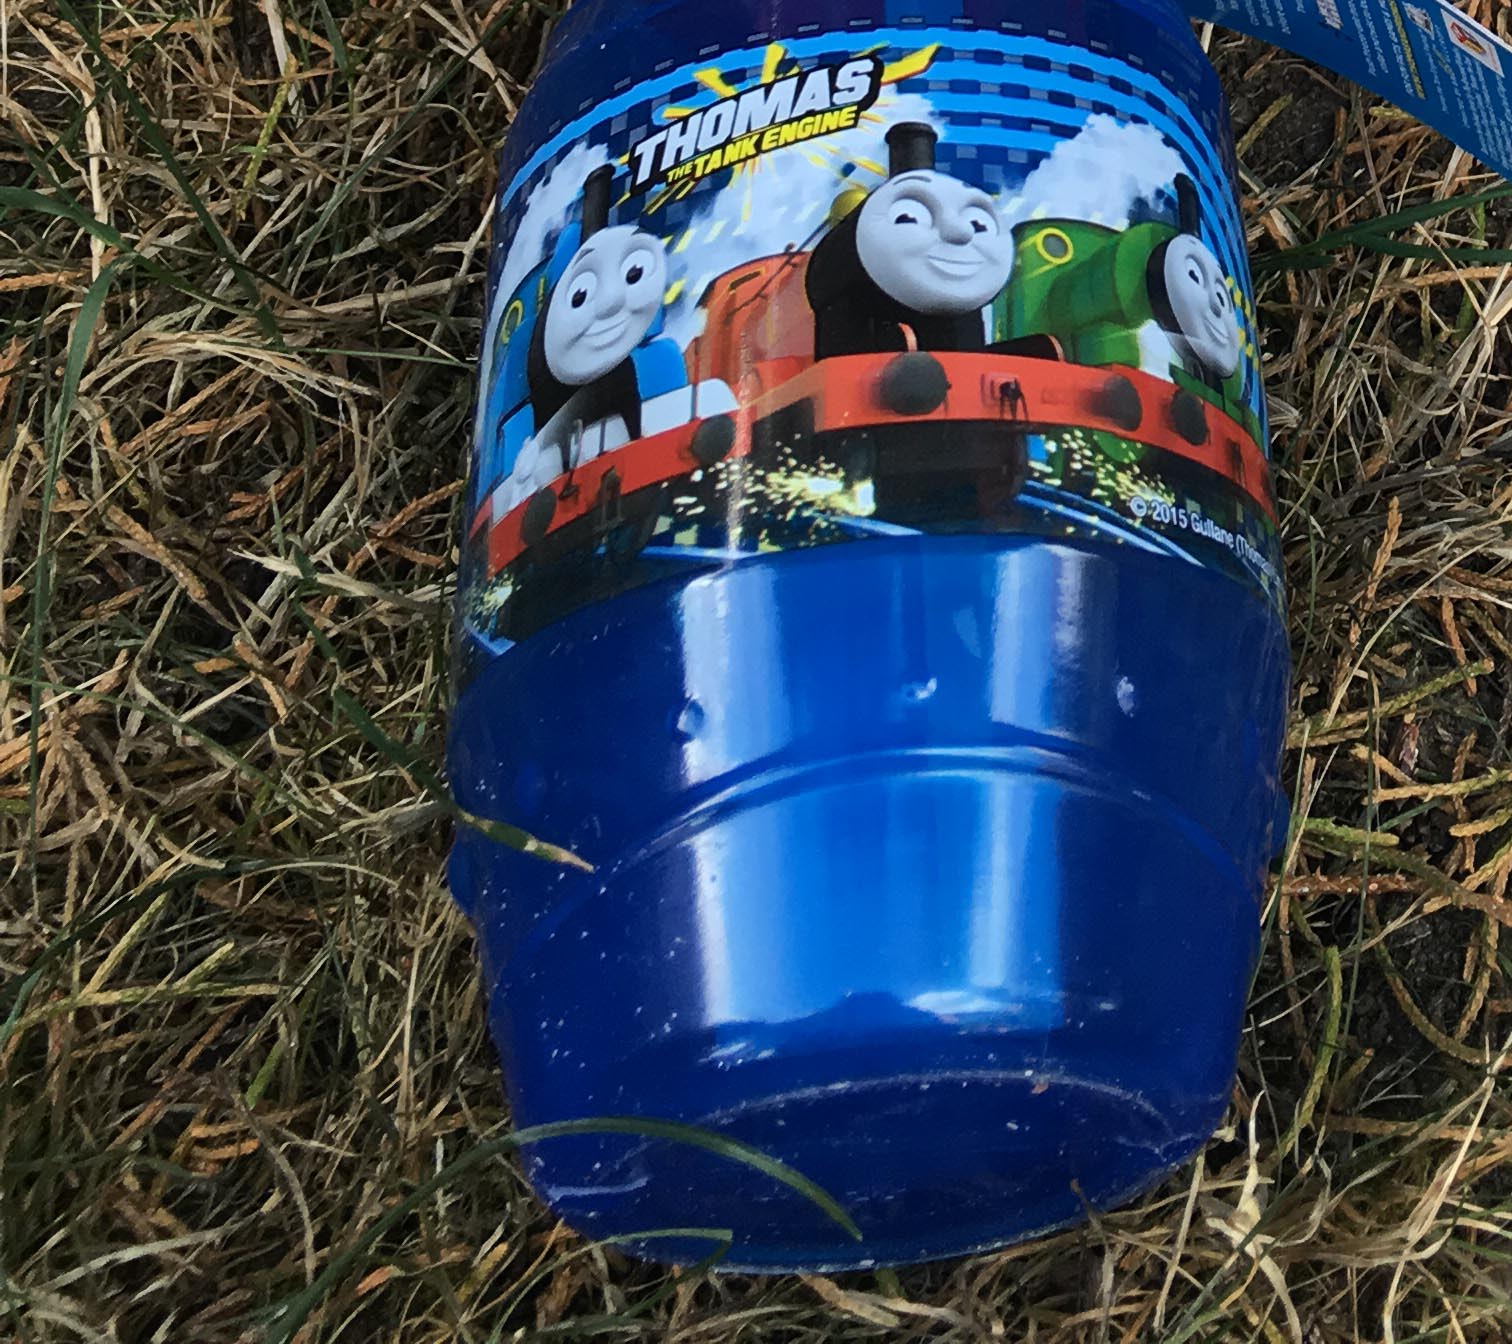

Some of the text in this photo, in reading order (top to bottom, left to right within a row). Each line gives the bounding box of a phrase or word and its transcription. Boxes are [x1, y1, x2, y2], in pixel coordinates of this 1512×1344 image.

[634, 58, 875, 186] THOMAS
[667, 105, 858, 185] THE TANK ENGINE
[1151, 501, 1189, 529] 2015
[1190, 512, 1235, 549] Gullane
